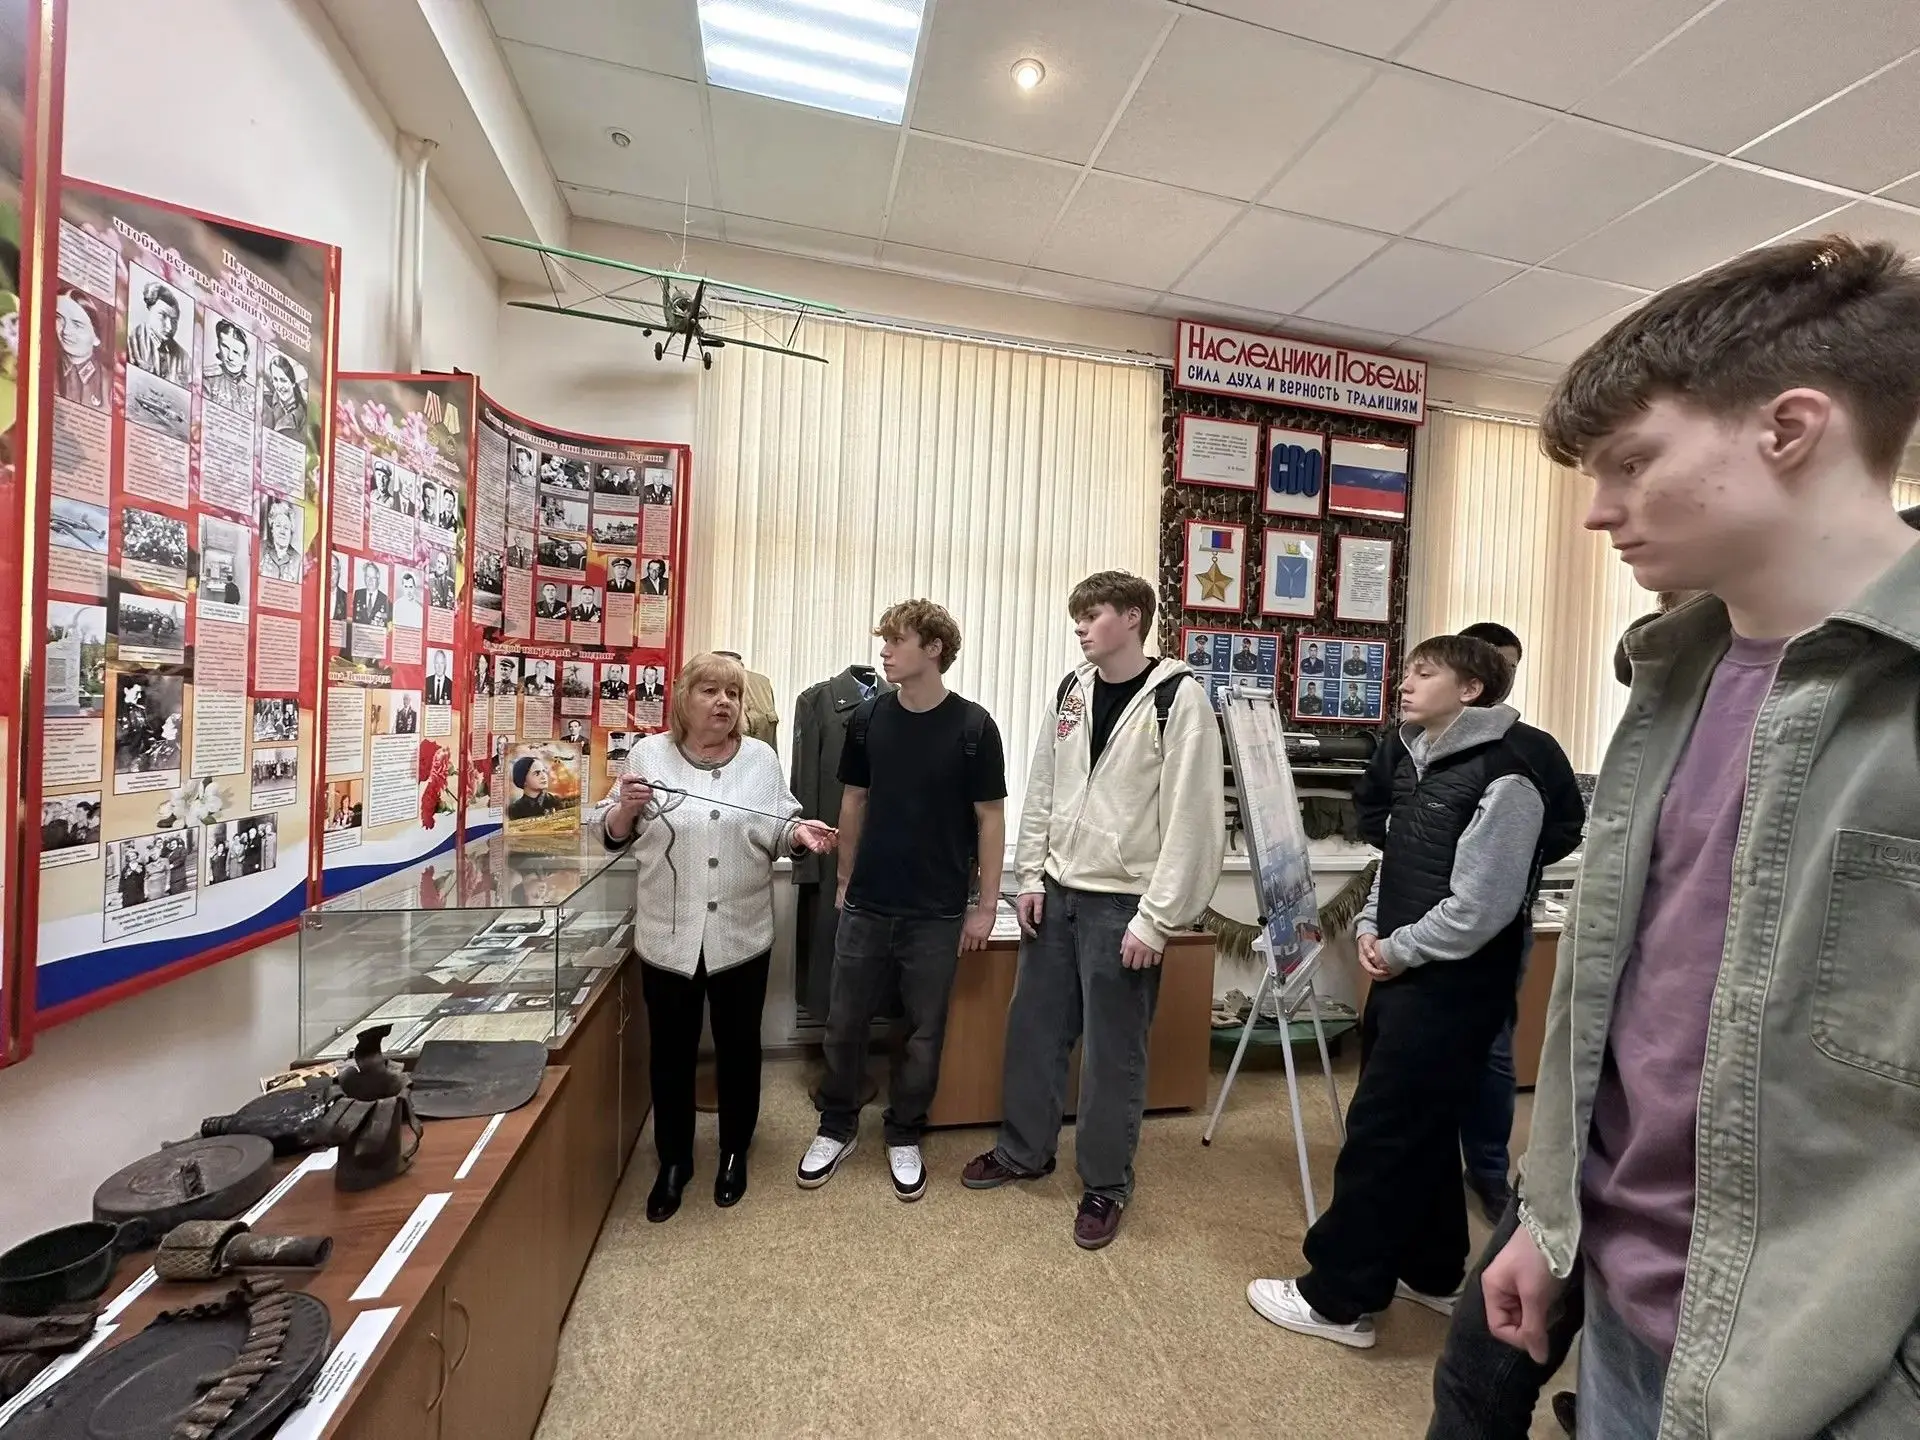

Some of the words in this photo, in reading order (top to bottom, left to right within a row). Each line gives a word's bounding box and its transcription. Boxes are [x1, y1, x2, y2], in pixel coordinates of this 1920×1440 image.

[113, 216, 163, 258] чтобы
[164, 250, 211, 288] встать
[211, 279, 227, 299] на
[230, 294, 271, 327] защиту
[223, 249, 236, 268] И
[236, 262, 284, 304] девушки
[284, 296, 313, 324] наши
[230, 274, 269, 309] надели
[1187, 364, 1221, 384] СИЛА
[1226, 371, 1262, 390] ДУХА
[1267, 376, 1275, 392] И
[1346, 389, 1418, 415] ТРАДИЦИЯМ
